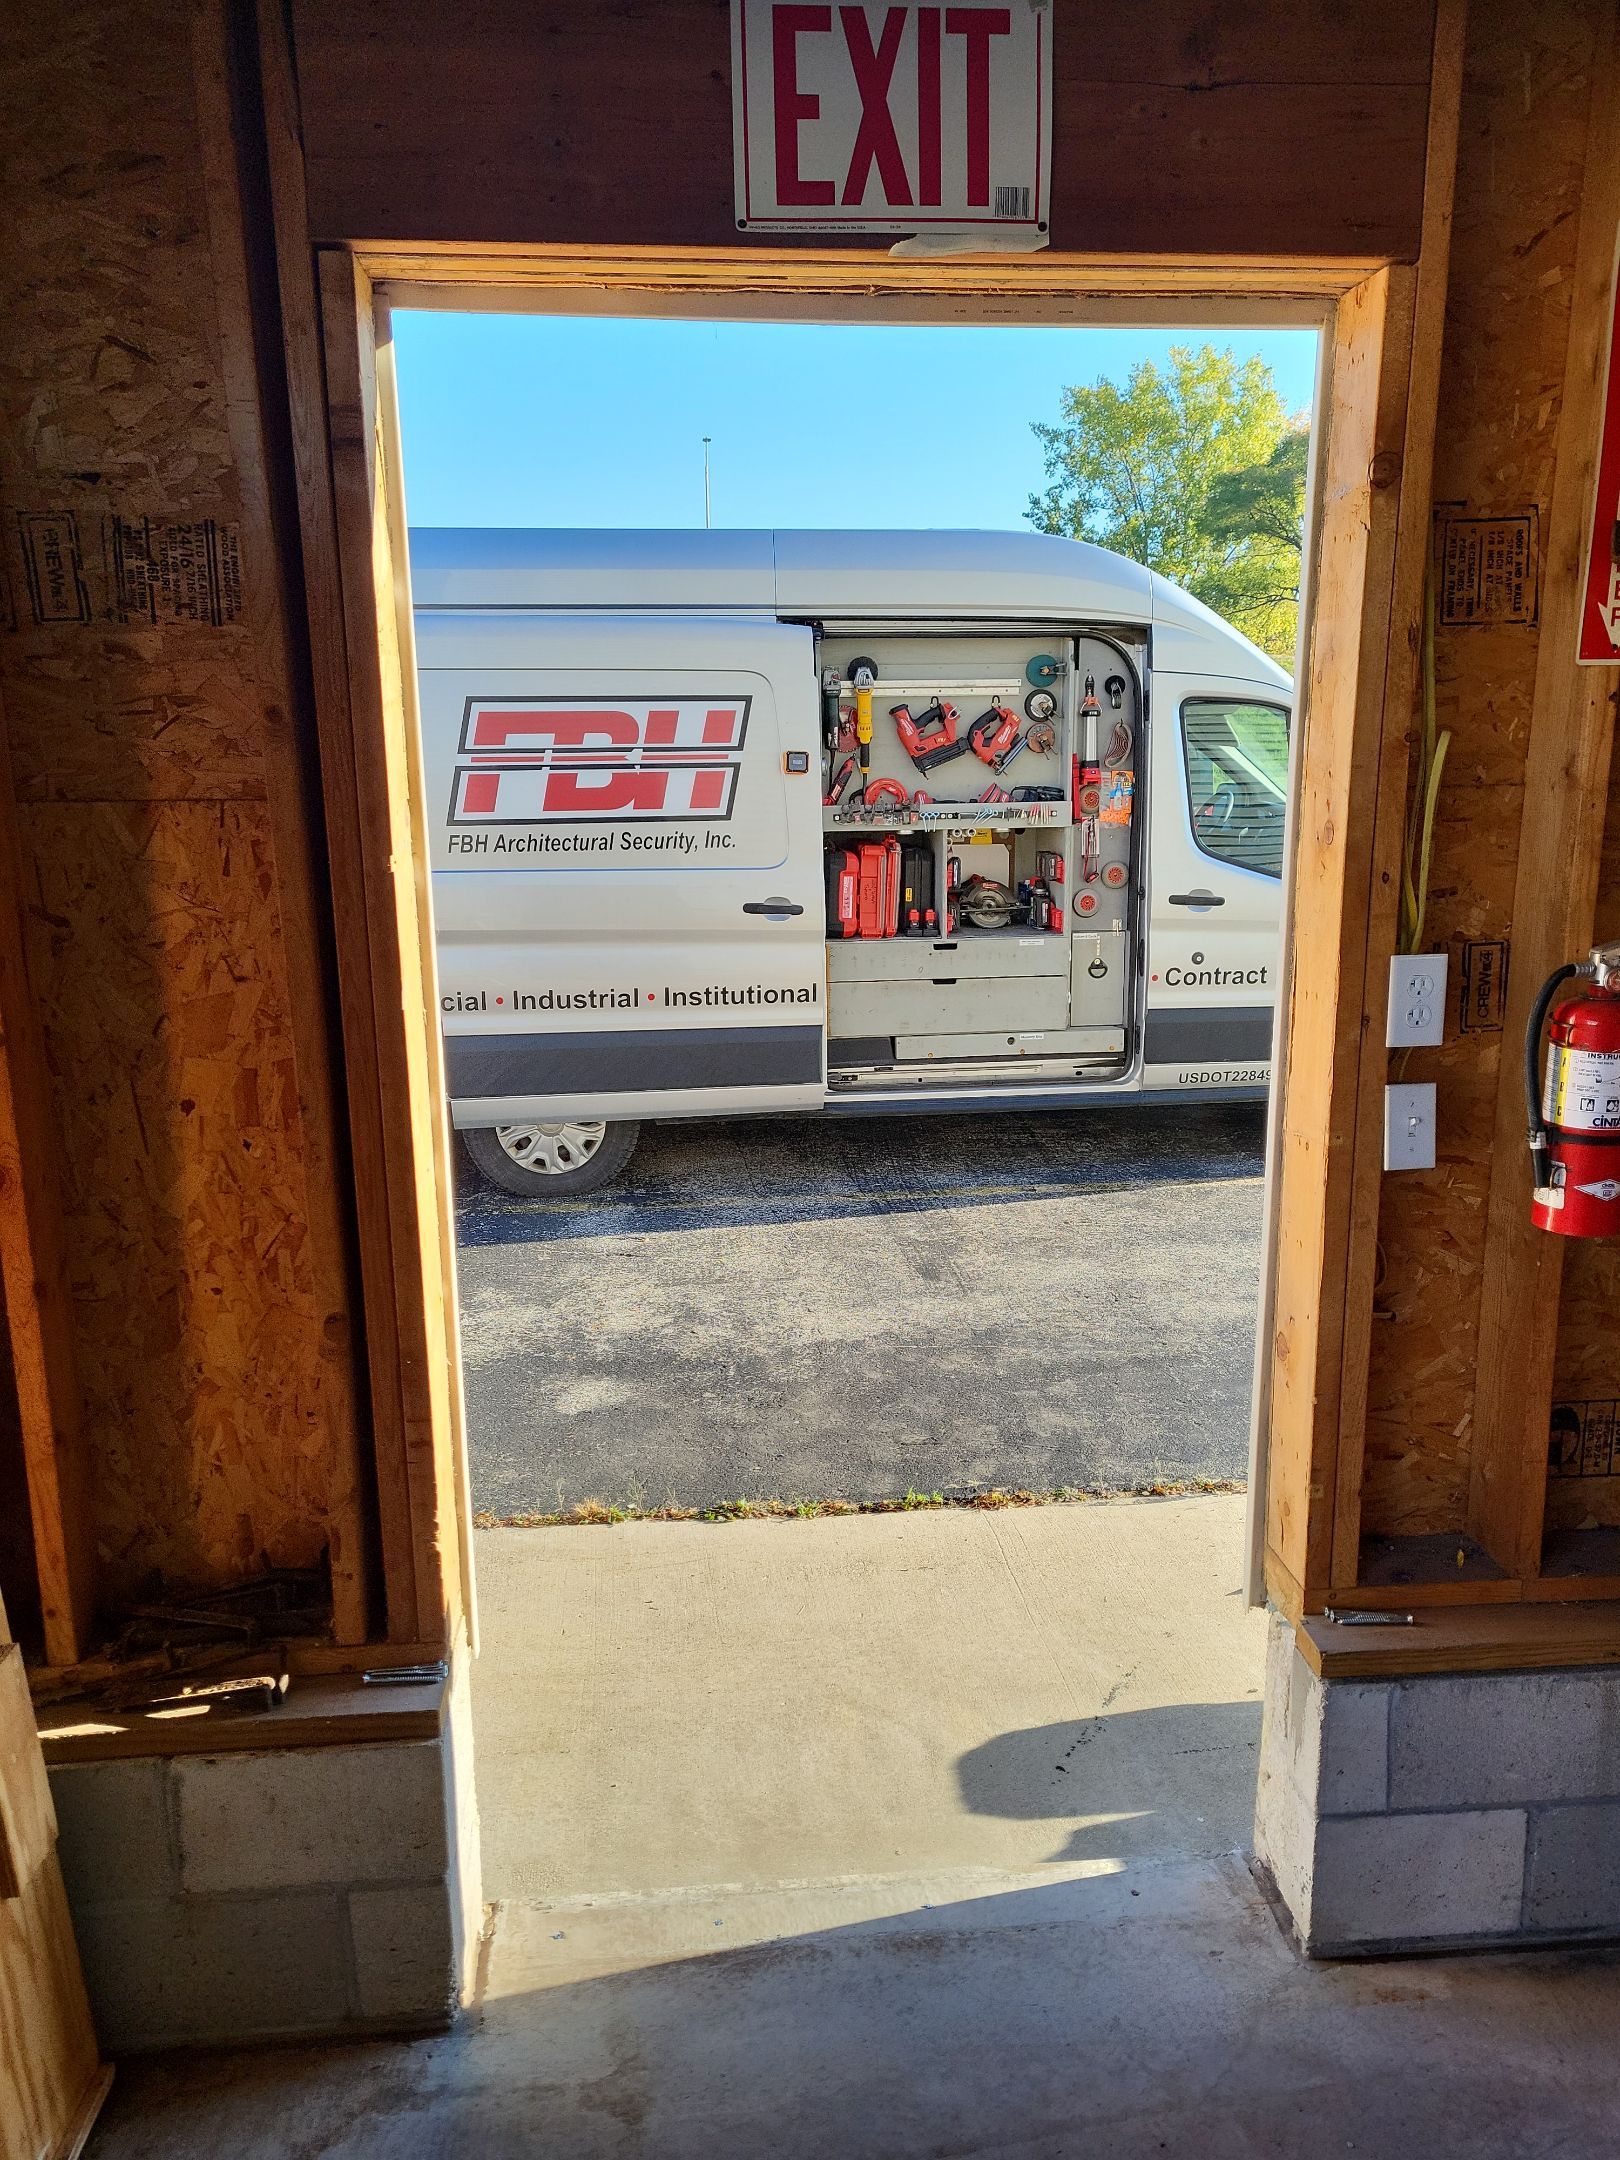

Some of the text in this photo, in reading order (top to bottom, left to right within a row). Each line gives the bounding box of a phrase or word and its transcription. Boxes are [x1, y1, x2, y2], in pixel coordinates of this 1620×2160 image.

[772, 4, 1011, 207] EXIT
[178, 523, 194, 569] 24/16
[221, 527, 231, 557] WOOD
[159, 540, 171, 593] EXPOSURE
[185, 570, 196, 593] 7/16
[462, 710, 737, 813] FBH
[448, 830, 737, 854] FBH Architectural Security, Inc.
[1165, 966, 1268, 987] Contract
[513, 988, 639, 1011] Industrial
[664, 983, 818, 1008] Institutional
[1587, 1052, 1620, 1060] INSTRU
